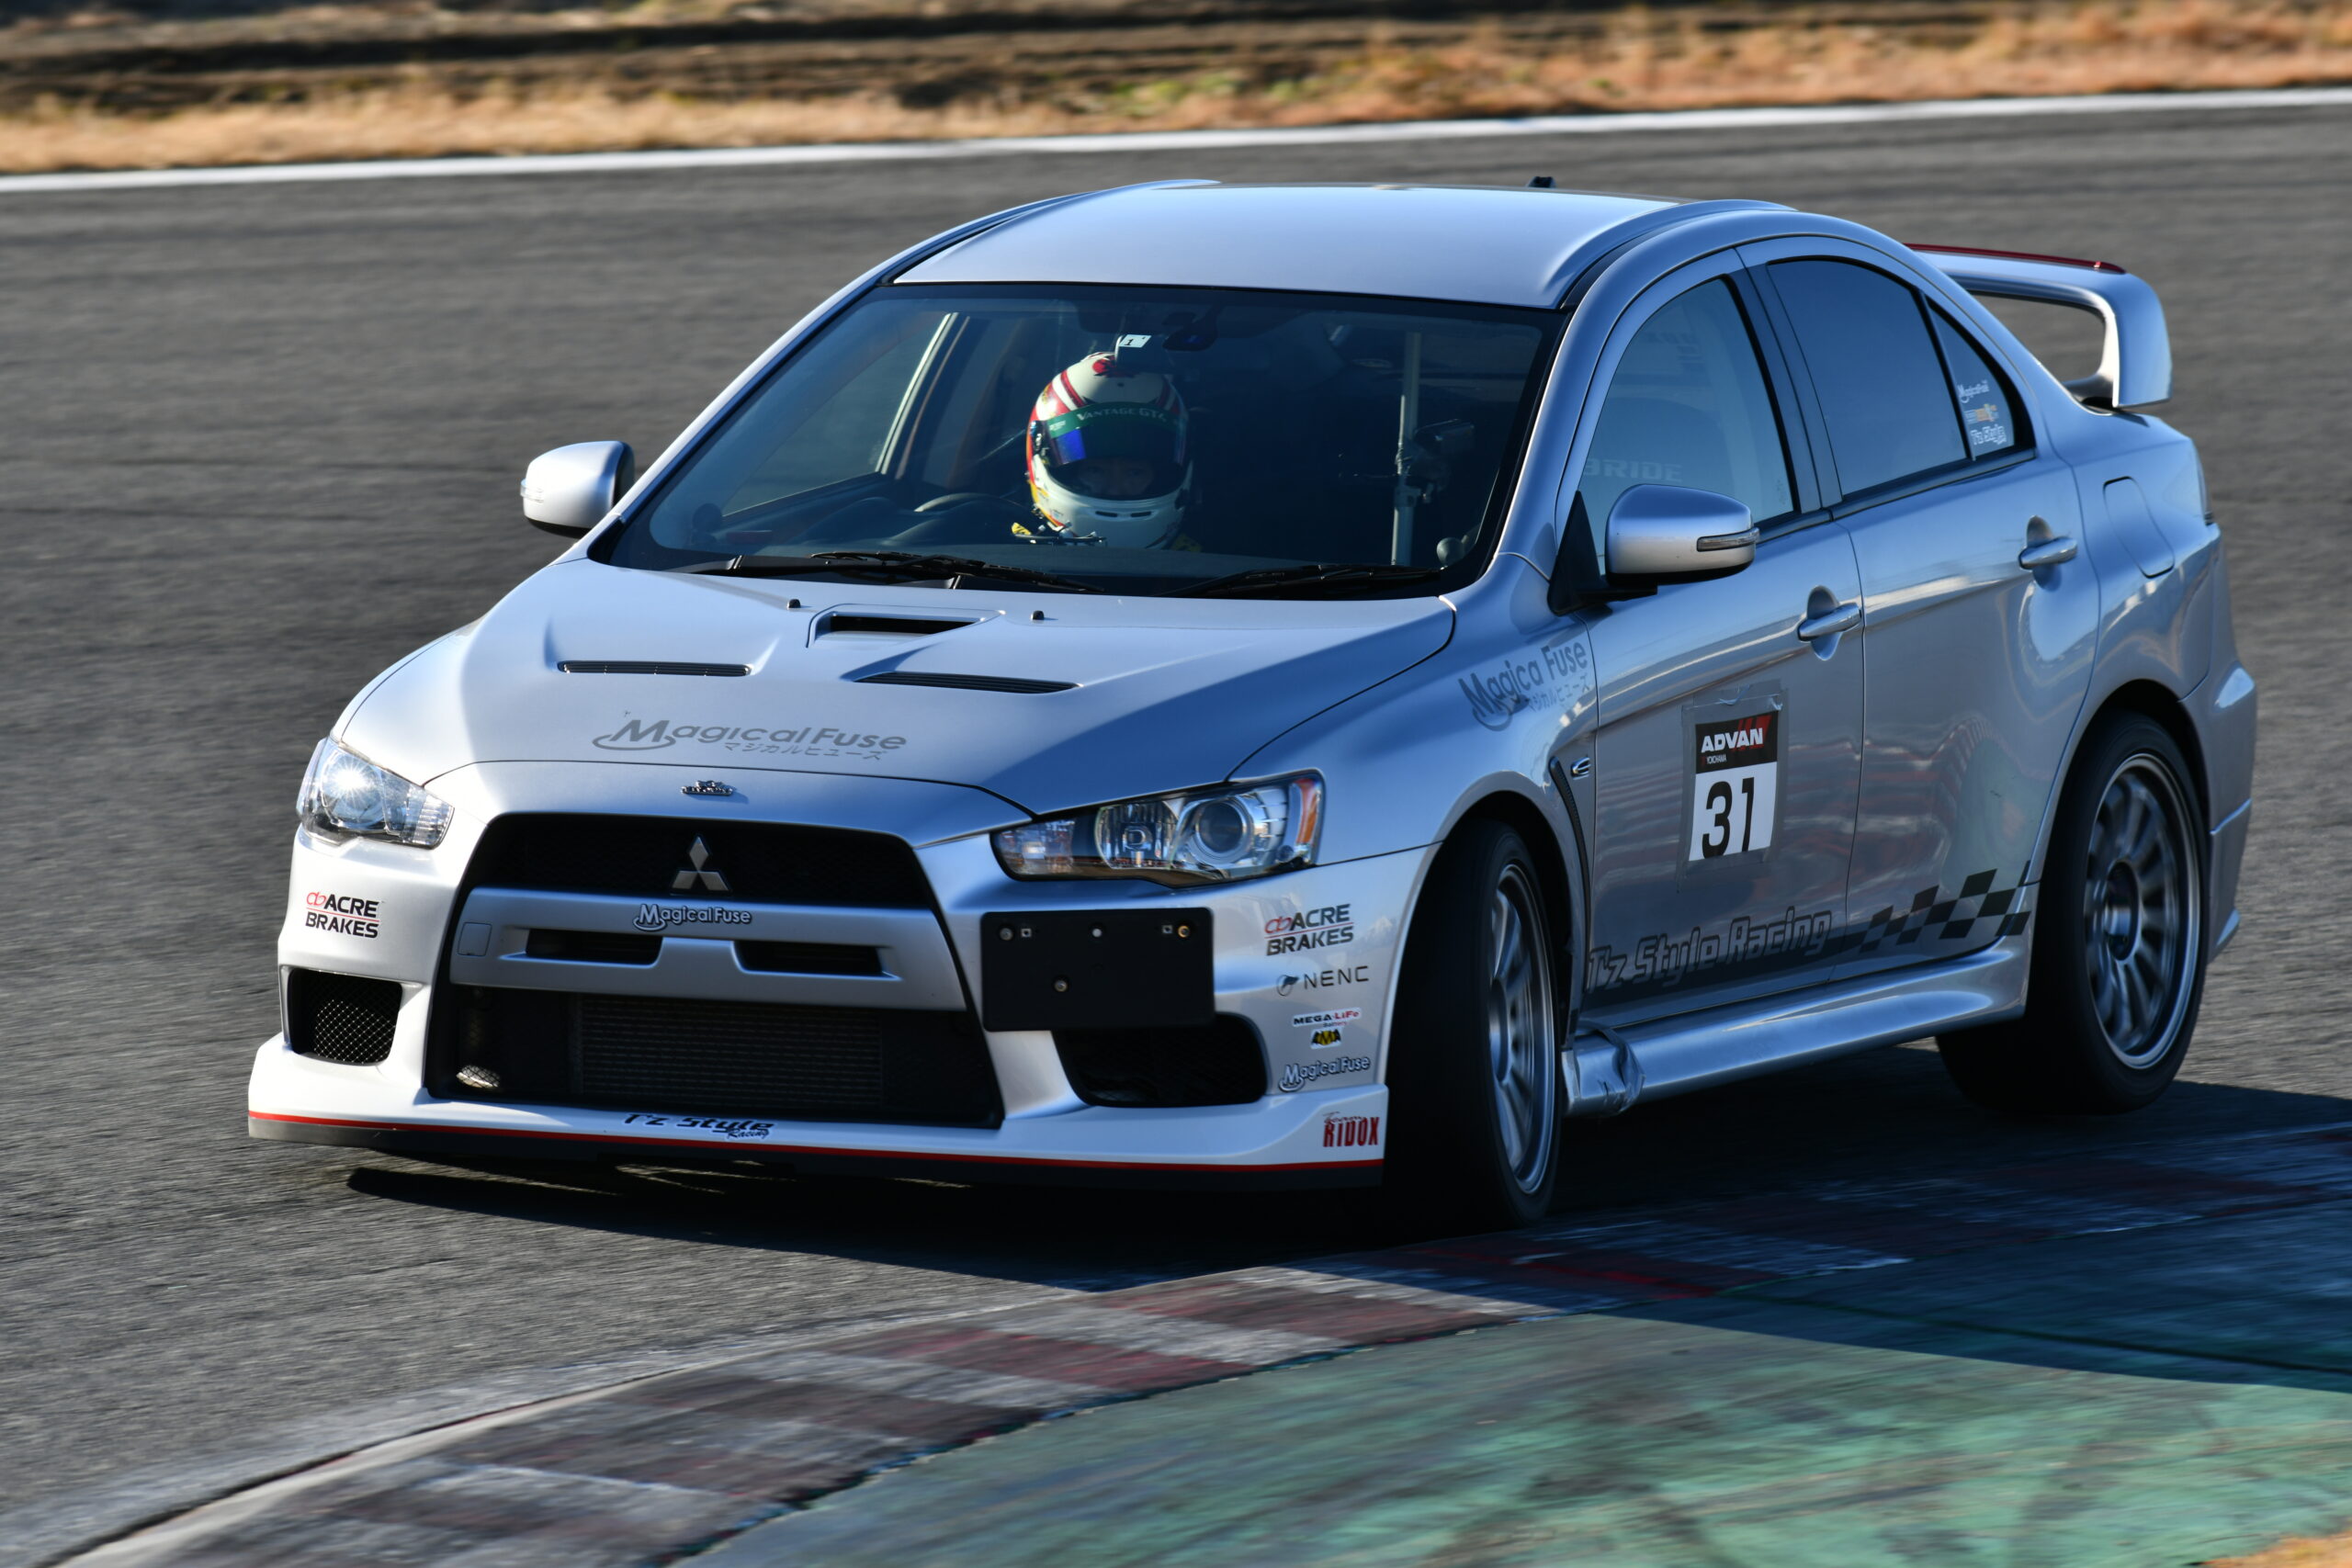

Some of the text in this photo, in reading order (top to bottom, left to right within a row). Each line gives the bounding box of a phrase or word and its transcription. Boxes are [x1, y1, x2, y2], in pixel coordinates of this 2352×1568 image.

[1541, 641, 1588, 681] Fuse
[724, 741, 888, 761] マジカルヒューズ
[1701, 727, 1764, 753] ADVAN
[1702, 777, 1755, 859] 31
[305, 911, 380, 939] BRAKES
[1266, 926, 1354, 956] BRAKES
[1632, 926, 1721, 988] Style
[1725, 906, 1832, 963] Racing
[1303, 966, 1370, 990] NENC
[1293, 1013, 1332, 1025] MEGA
[676, 1117, 775, 1134] Style
[727, 1128, 770, 1140] Racing
[1323, 1116, 1380, 1147] RIDOX
